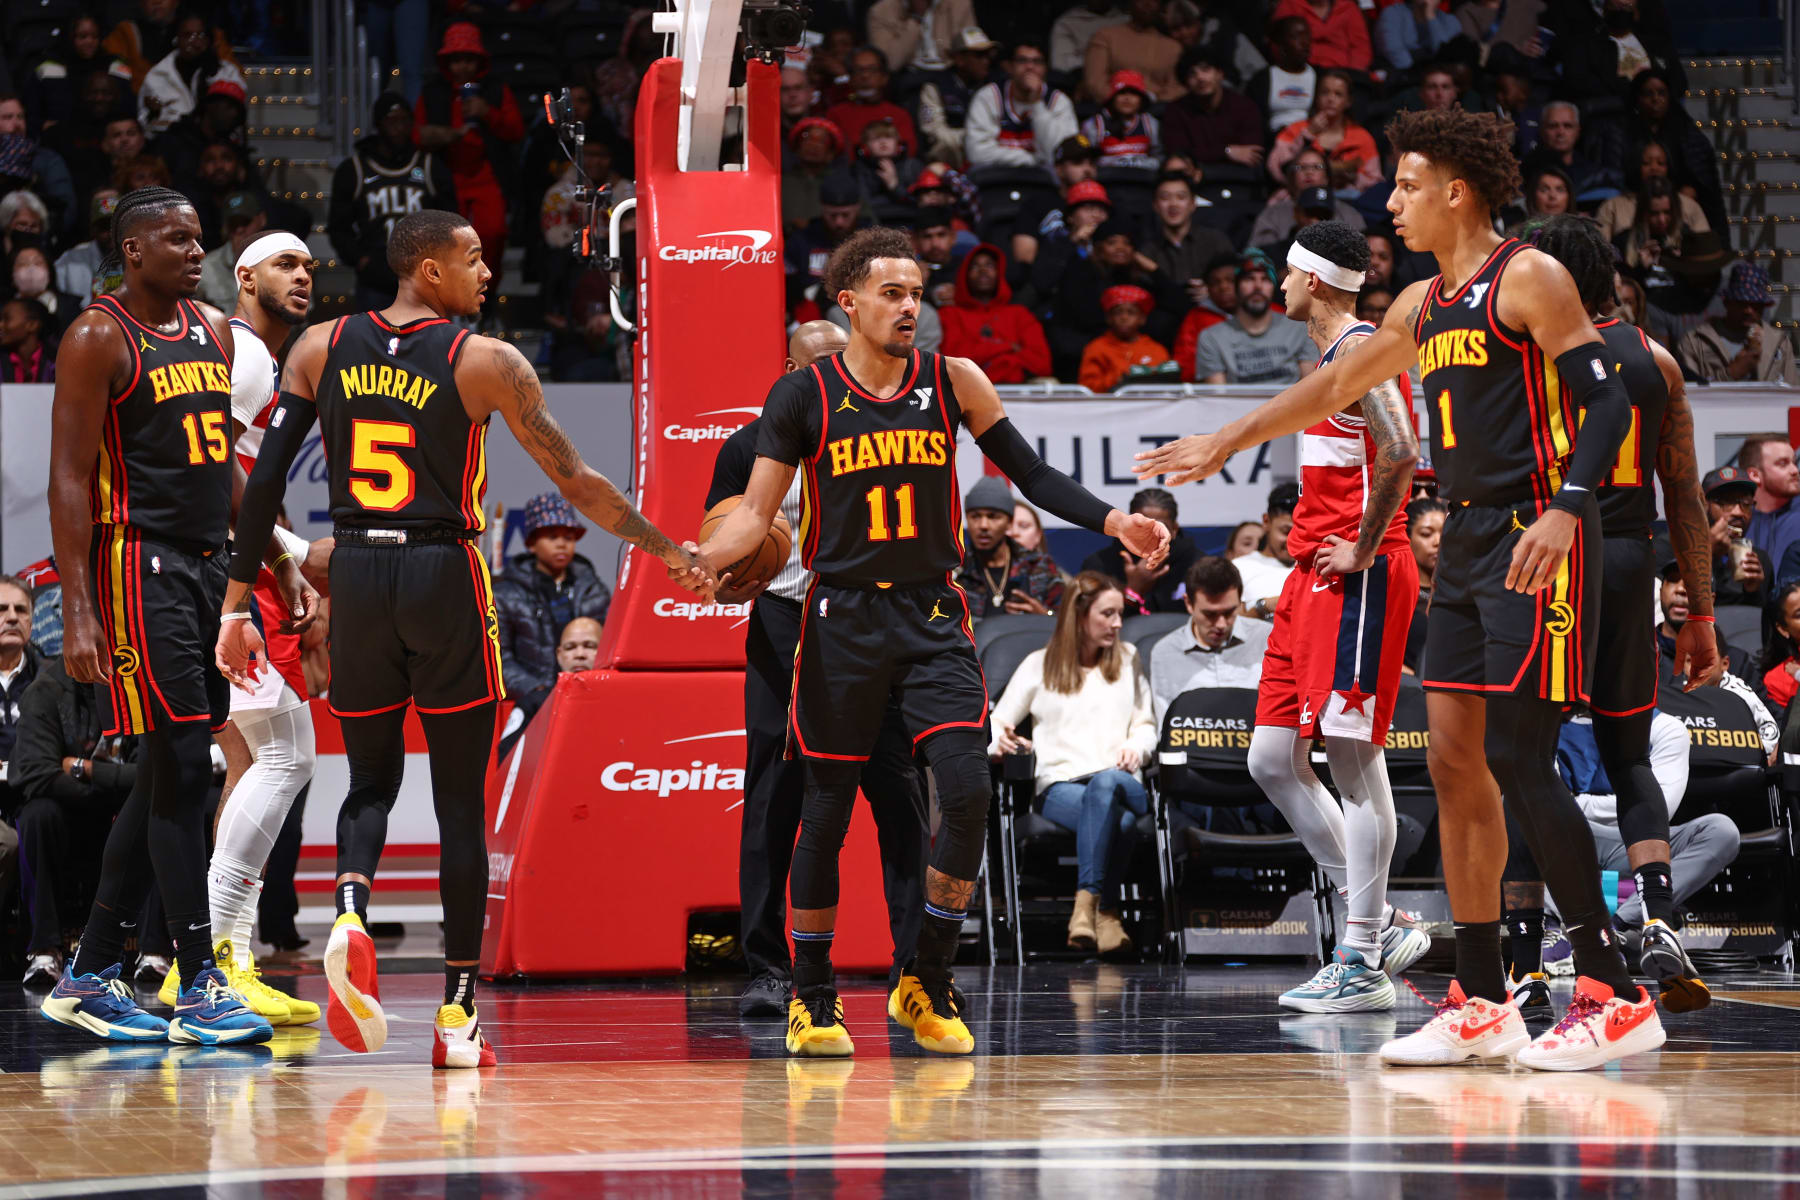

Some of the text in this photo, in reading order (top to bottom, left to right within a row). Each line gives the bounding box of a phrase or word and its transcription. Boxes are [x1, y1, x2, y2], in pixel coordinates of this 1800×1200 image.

[366, 185, 424, 219] MLK
[1418, 328, 1489, 384] HAWKS
[148, 360, 231, 404] HAWKS
[339, 364, 438, 410] MURRAY
[181, 410, 229, 466] 15
[1437, 388, 1457, 449] 1
[349, 418, 416, 513] 5
[828, 428, 947, 478] HAWKS
[865, 482, 919, 542] 11
[1169, 716, 1247, 730] CAESARS
[1169, 730, 1254, 748] SPORTS
[1219, 910, 1272, 920] CAESARS
[1219, 920, 1309, 936] SPORTSBOOK
